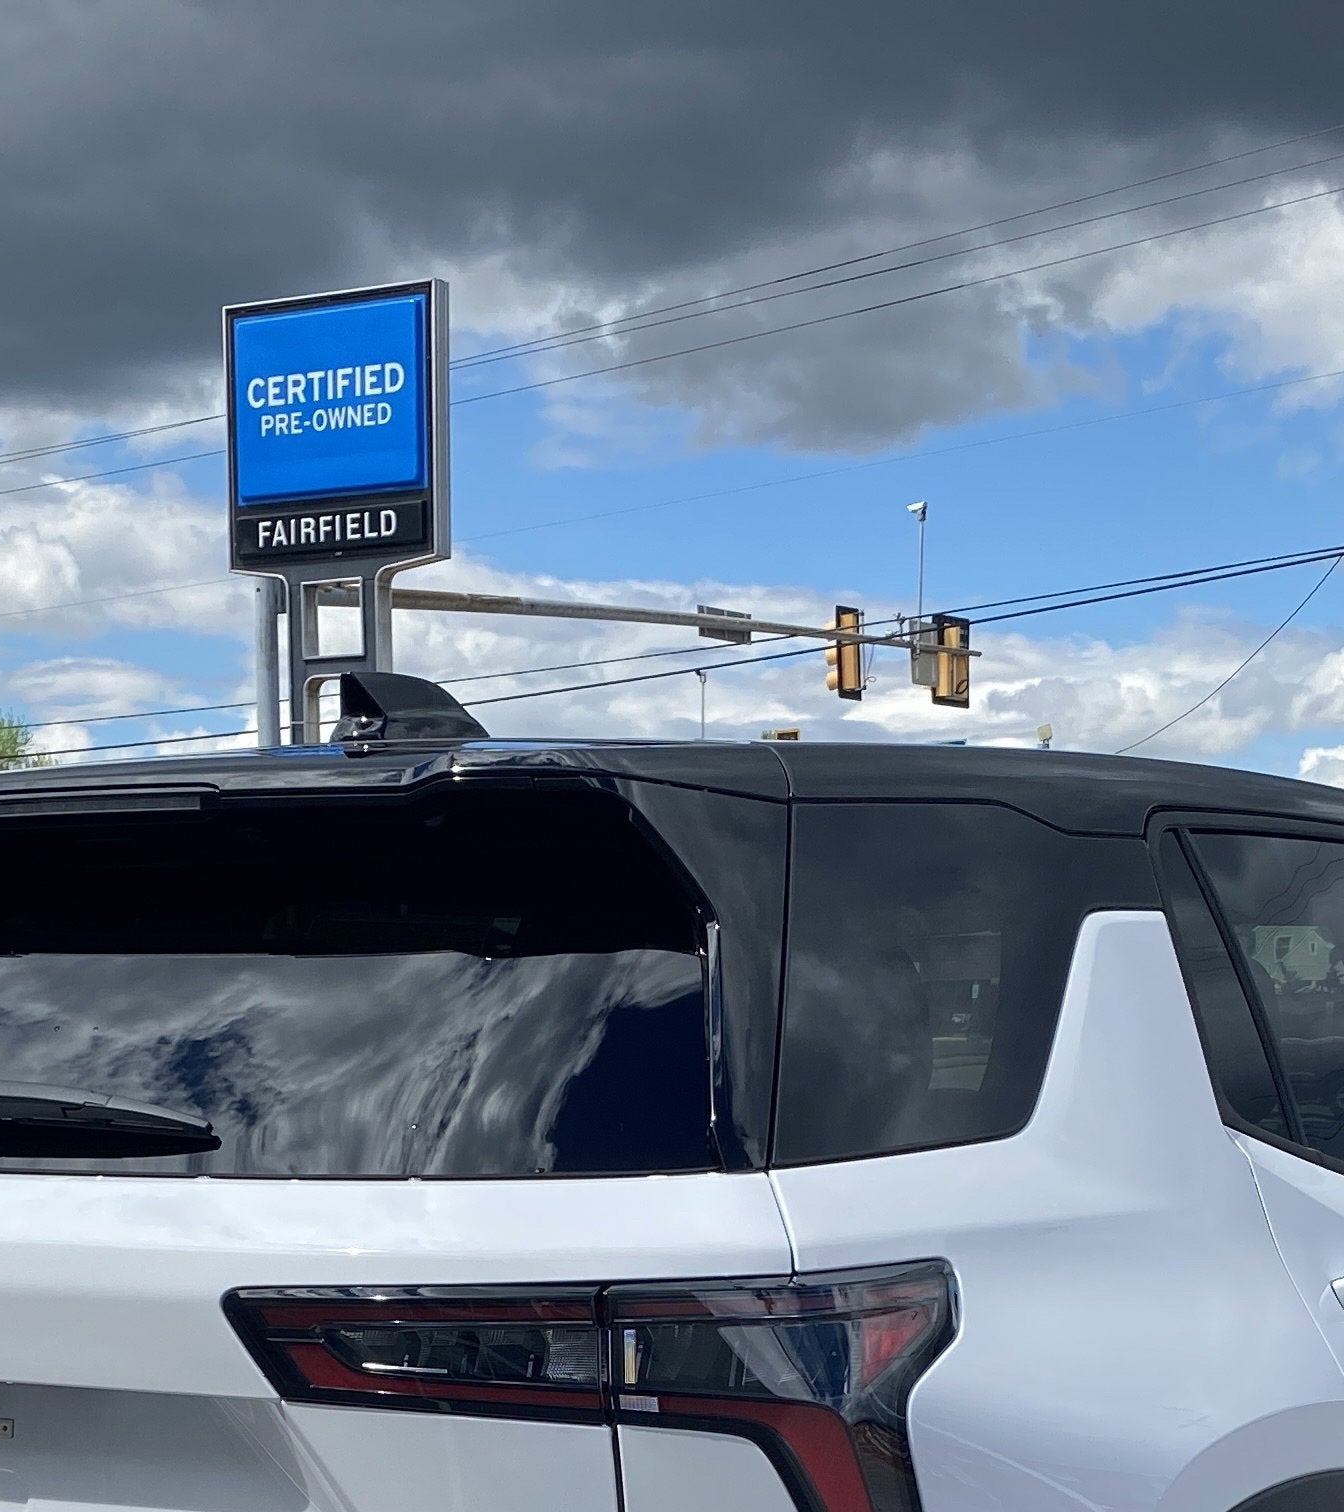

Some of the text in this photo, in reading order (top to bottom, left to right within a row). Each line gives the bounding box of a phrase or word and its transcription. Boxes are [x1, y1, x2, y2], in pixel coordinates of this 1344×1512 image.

[247, 362, 405, 408] CERTIFIED
[260, 402, 392, 437] PRE-OWNED
[257, 509, 398, 548] FAIRFIELD
